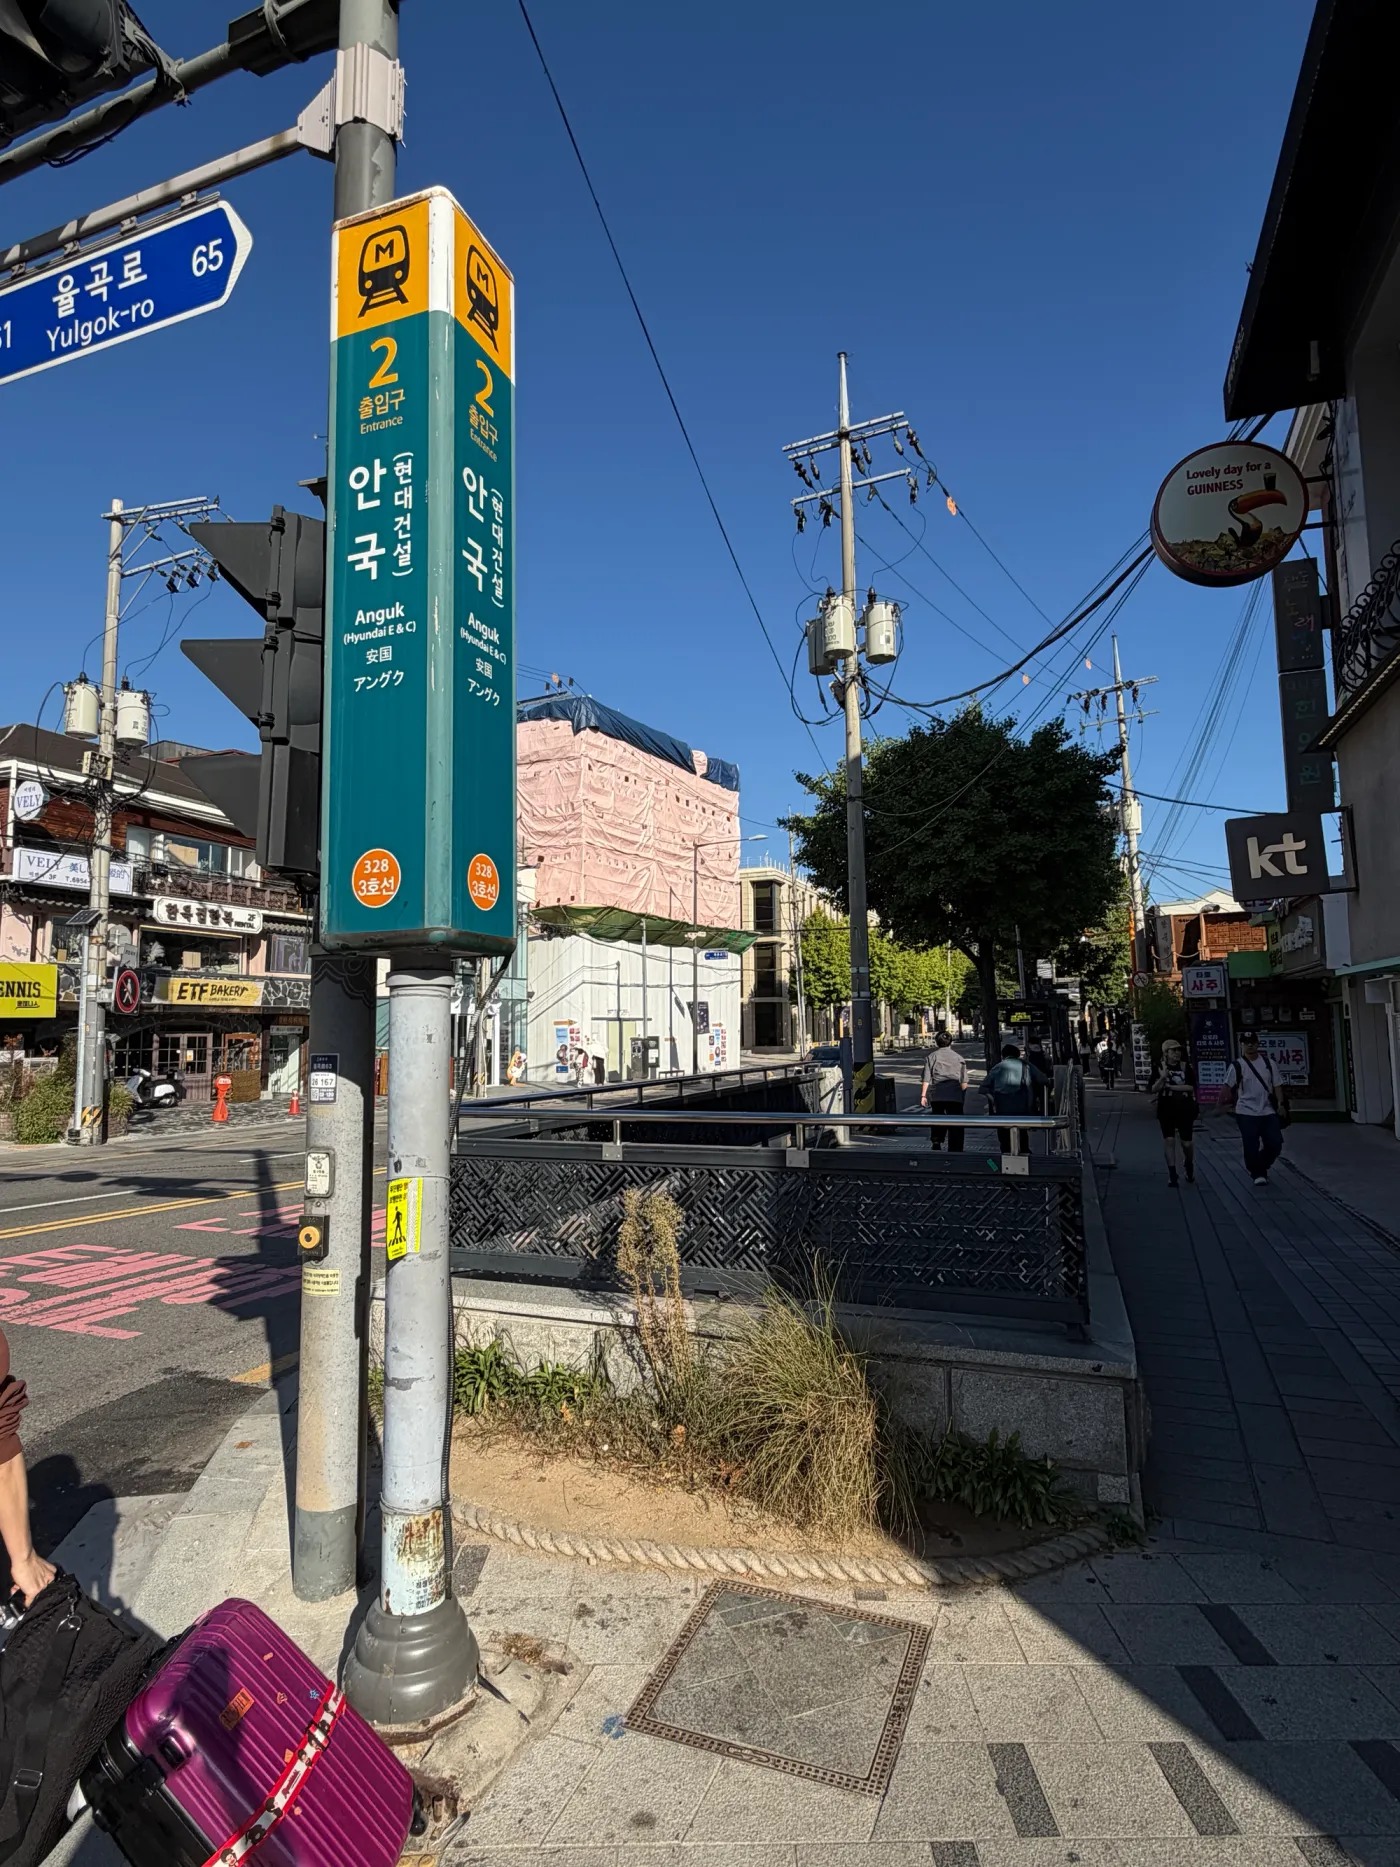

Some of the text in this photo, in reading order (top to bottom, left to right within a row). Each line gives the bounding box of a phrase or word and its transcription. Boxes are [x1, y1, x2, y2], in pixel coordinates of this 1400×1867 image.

[191, 238, 223, 277] 65
[374, 238, 394, 263] M
[52, 250, 148, 318] 율곡로
[476, 261, 490, 293] M
[46, 299, 155, 352] Yulgok-ro
[368, 336, 399, 388] 2
[475, 359, 494, 418] 2
[358, 388, 406, 420] 출입구
[360, 414, 404, 435] Entrance
[468, 404, 499, 446] 출입구
[470, 427, 498, 463] Entrance
[1186, 461, 1272, 481] Lovely day for a
[1186, 479, 1244, 496] GUINNESS
[347, 458, 387, 581] 안국
[392, 451, 414, 577] (현대건설)
[462, 466, 488, 593] 안국
[491, 487, 504, 608] (현대건설)
[354, 601, 405, 626] Anguk
[343, 620, 417, 645] (Hyundai E & C)
[468, 612, 500, 645] Anguk
[460, 627, 490, 656] (Hyundai
[365, 645, 393, 665] 安国
[353, 669, 405, 692] アングク
[475, 657, 493, 680] 安国
[467, 677, 501, 707] アングク
[16, 793, 42, 808] VELY
[27, 855, 62, 871] VELY
[363, 859, 389, 874] 328
[1246, 832, 1308, 879] kt
[475, 862, 493, 879] 328
[357, 876, 396, 897] 3호선
[471, 880, 497, 901] 3호선
[177, 982, 249, 1002] ETF BAKERY
[1191, 979, 1218, 991] 사주
[1278, 1049, 1304, 1065] 사주
